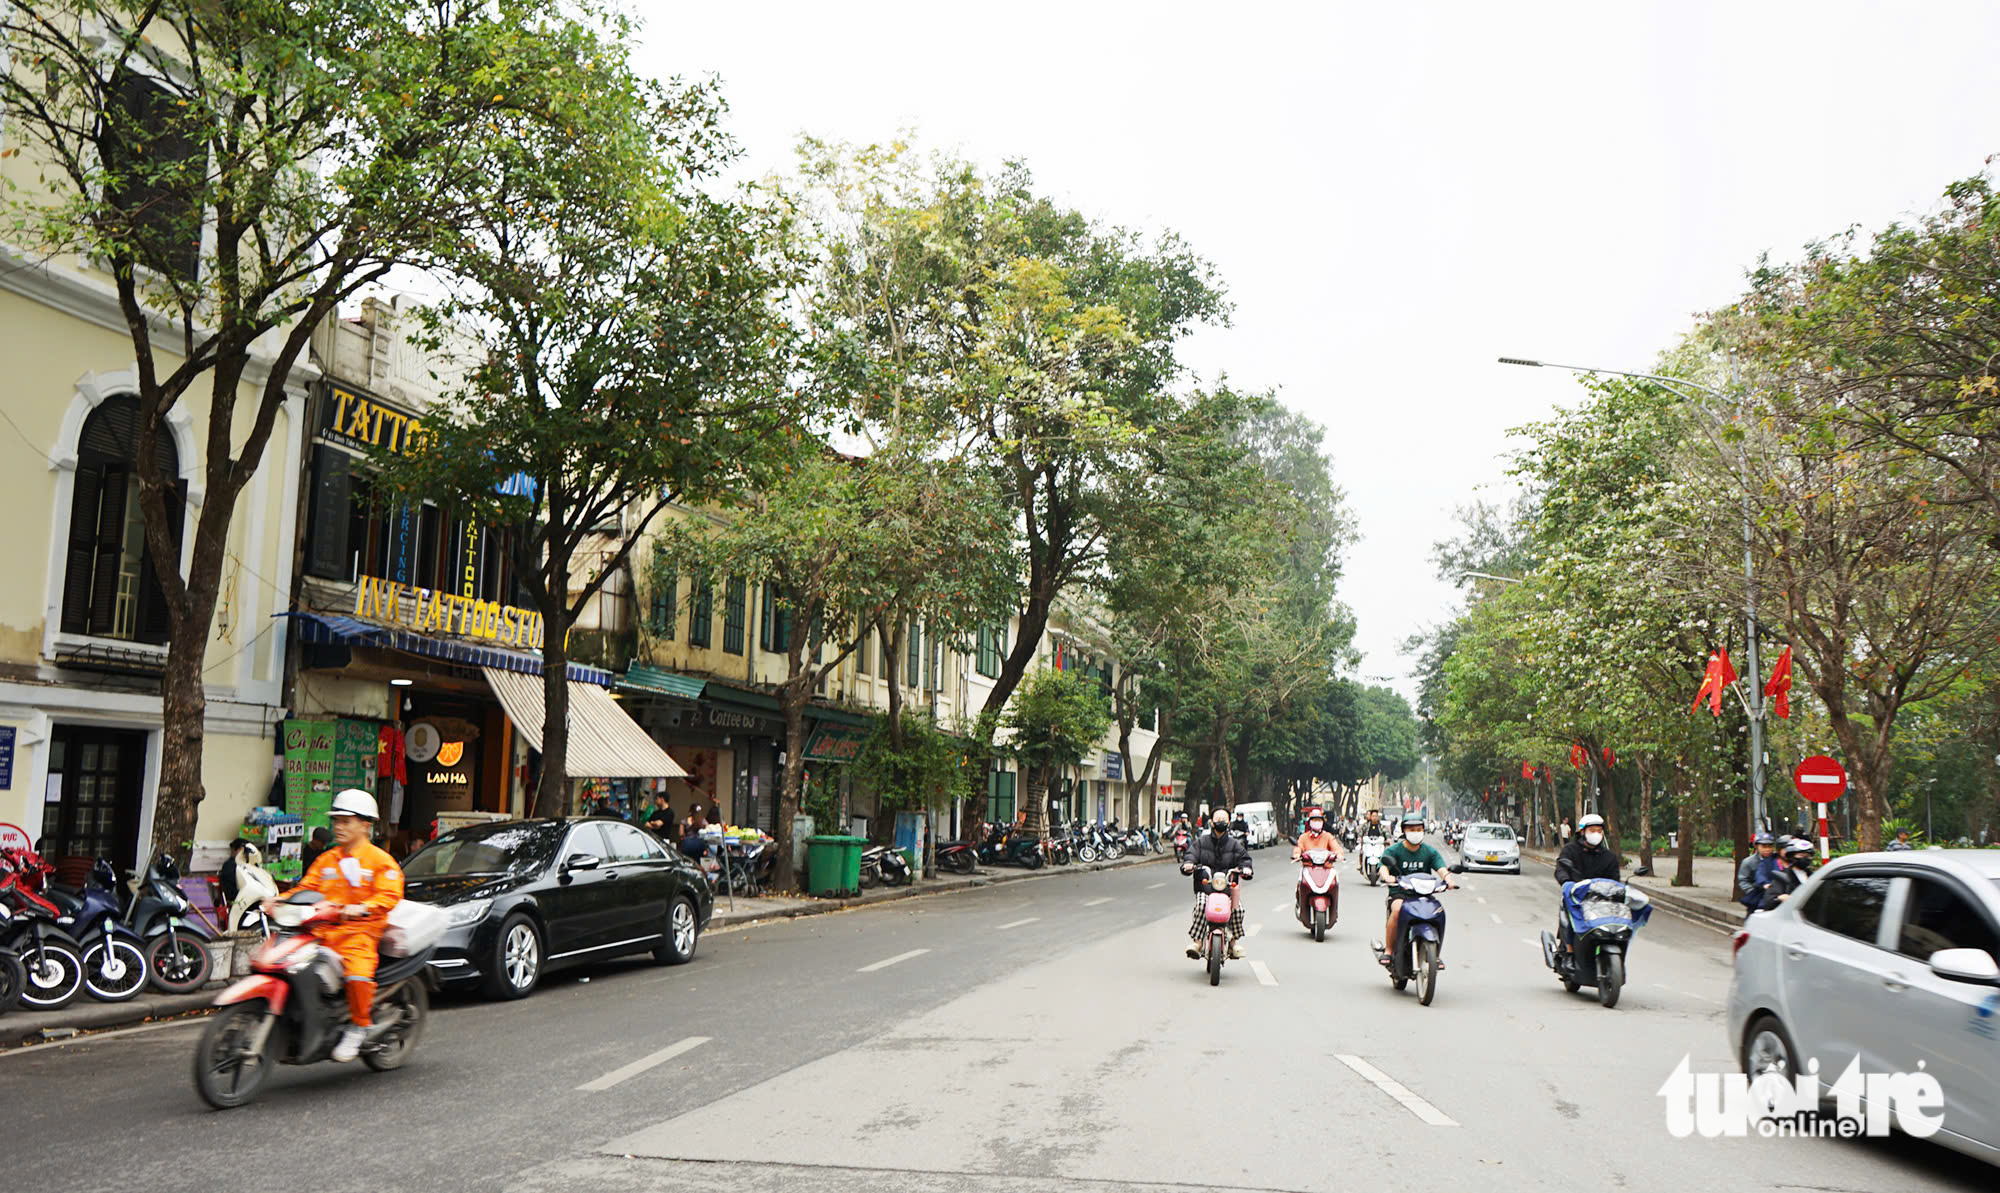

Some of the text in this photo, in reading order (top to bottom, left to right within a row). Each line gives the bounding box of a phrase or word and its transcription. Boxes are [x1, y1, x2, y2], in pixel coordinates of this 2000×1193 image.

[396, 500, 409, 582] ERCING
[354, 574, 406, 622] INK
[412, 586, 501, 639] TATTOO
[709, 708, 741, 727] Coffee
[427, 772, 449, 784] LAN
